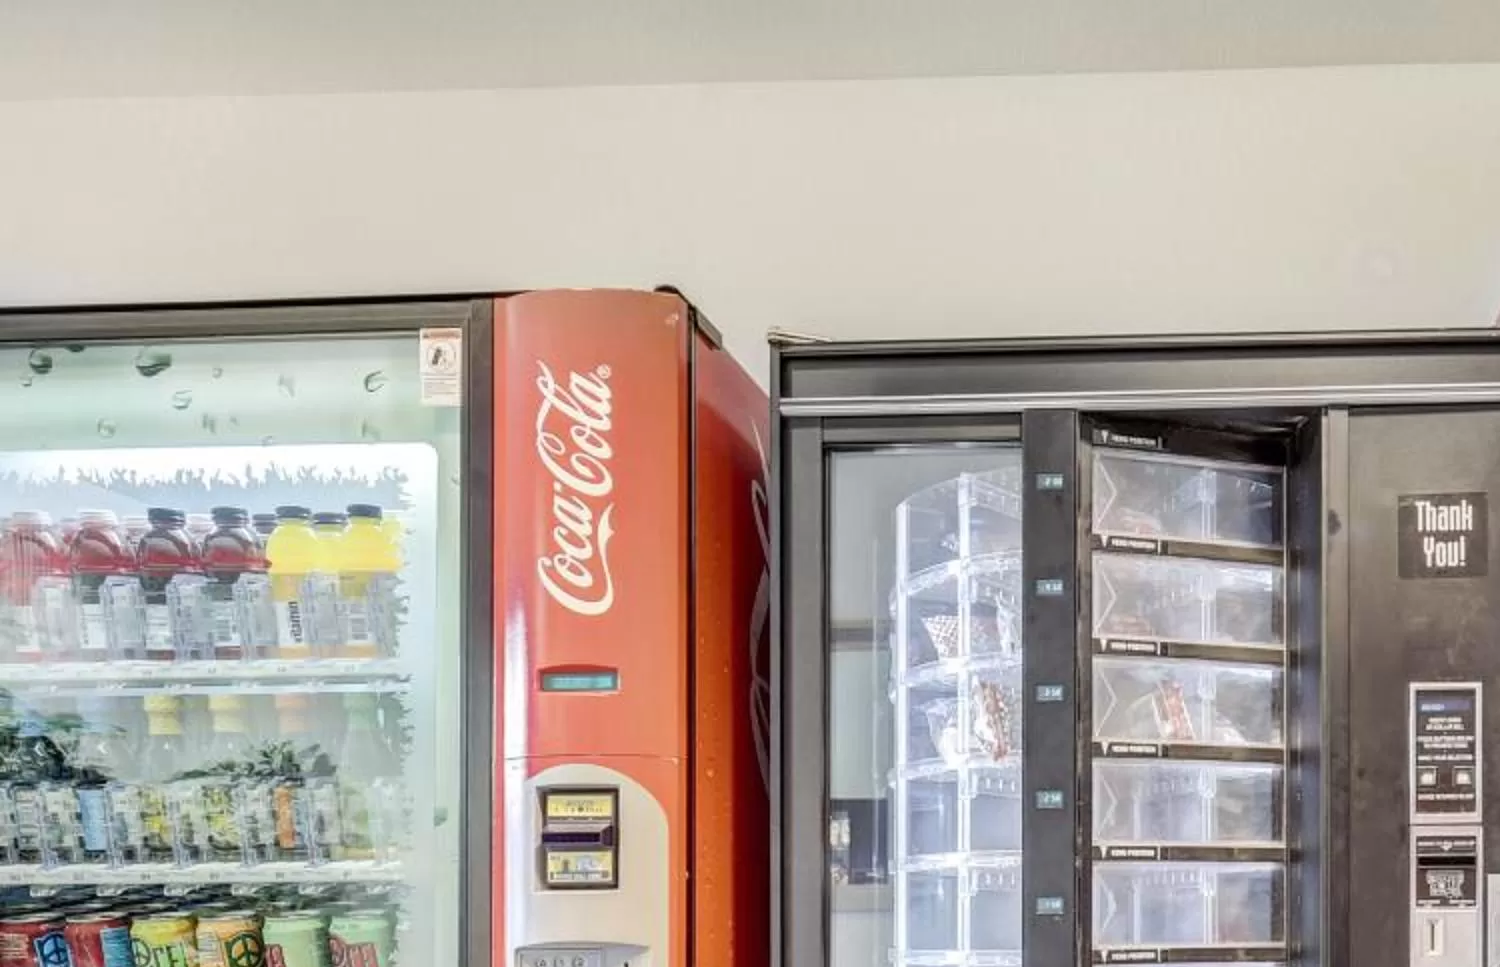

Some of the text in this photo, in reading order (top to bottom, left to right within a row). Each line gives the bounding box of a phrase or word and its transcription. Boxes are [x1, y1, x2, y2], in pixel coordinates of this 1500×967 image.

[536, 359, 615, 616] Coca-Cola
[1414, 500, 1473, 532] Thank
[1423, 536, 1466, 567] You!
